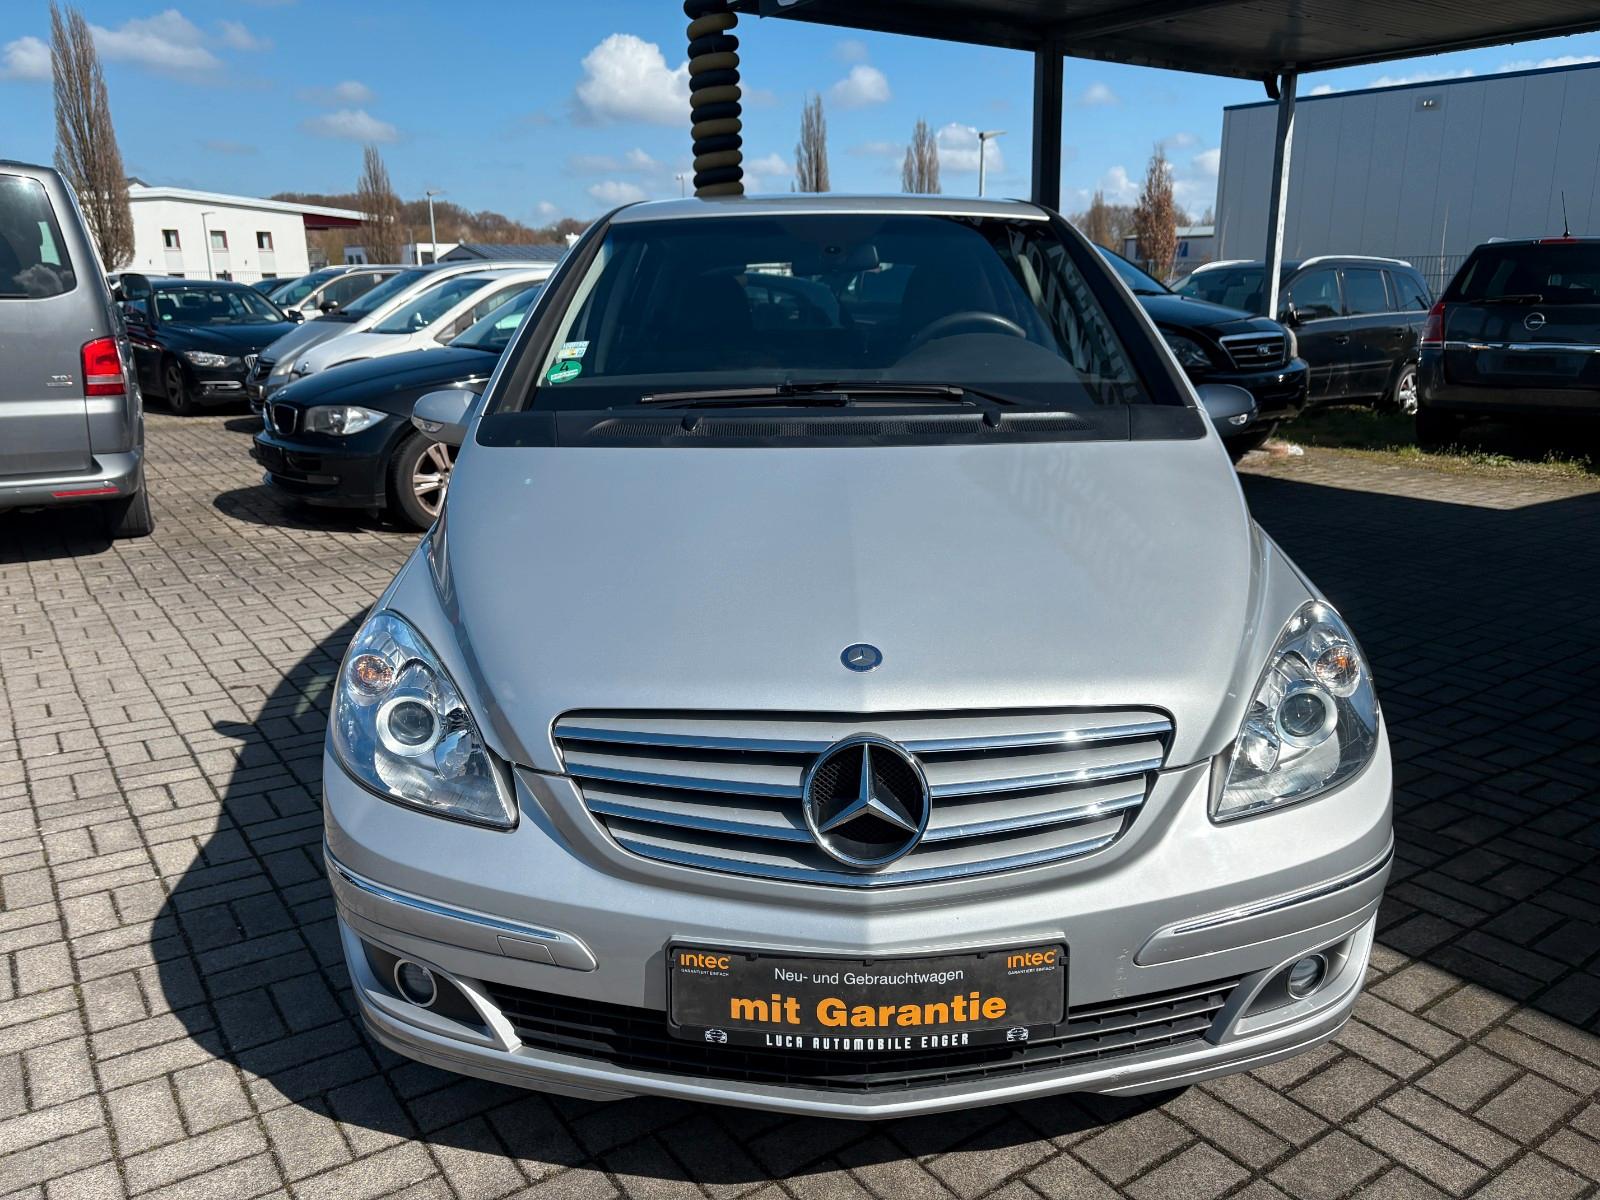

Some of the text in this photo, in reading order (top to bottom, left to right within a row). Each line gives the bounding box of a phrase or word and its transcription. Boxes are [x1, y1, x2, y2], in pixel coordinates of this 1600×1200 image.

[560, 362, 569, 371] 4
[774, 967, 964, 986] Neu- und Gebrauchtwagen
[730, 991, 1007, 1028] mit Garantie
[765, 1033, 969, 1051] LUCA AUTOMOBILE ENGER
